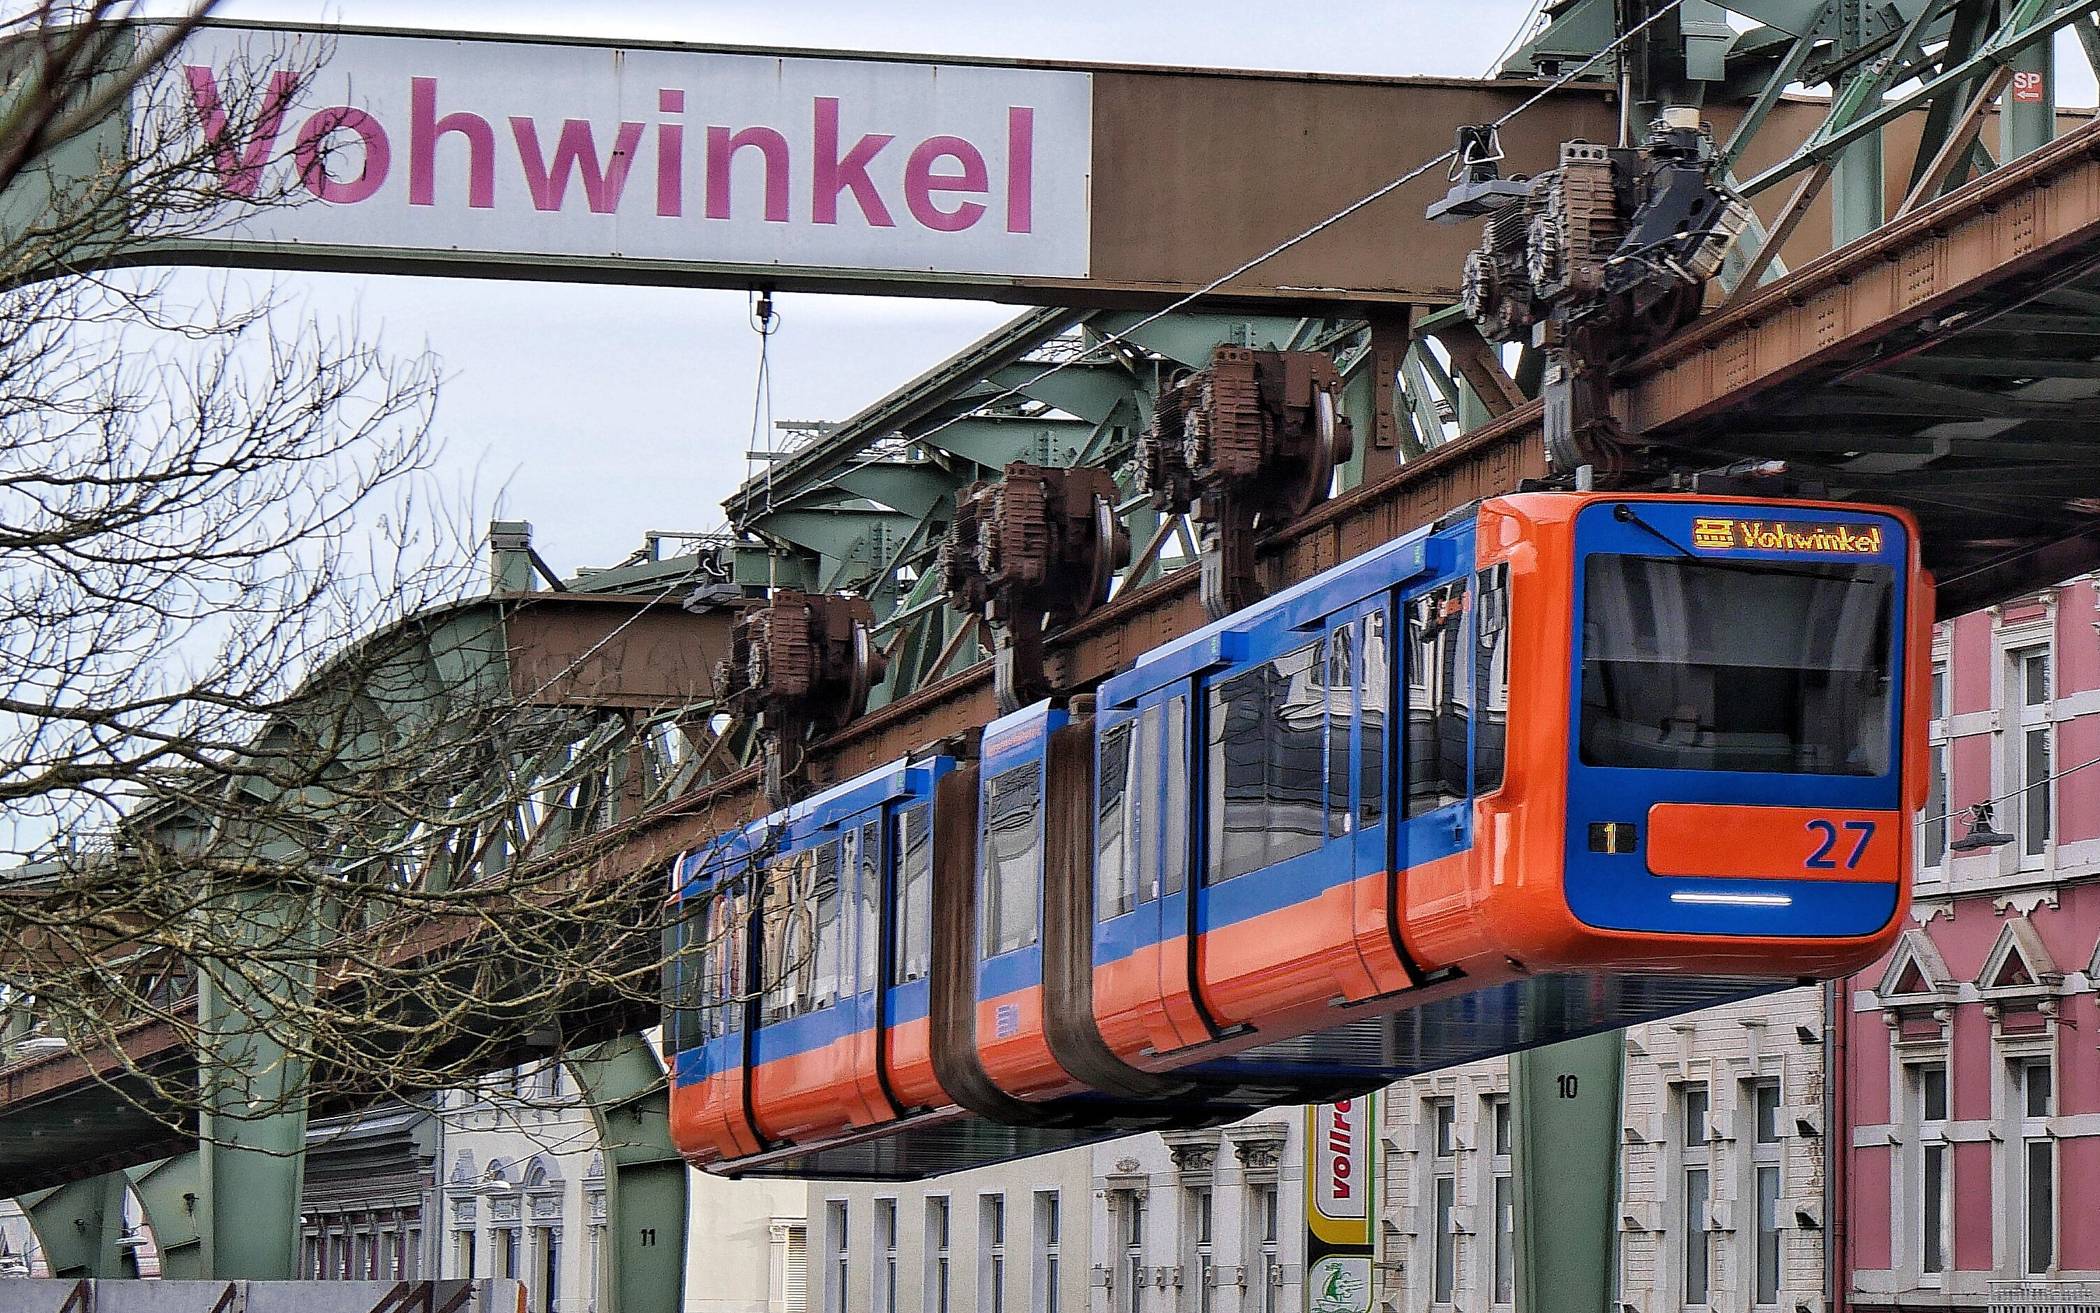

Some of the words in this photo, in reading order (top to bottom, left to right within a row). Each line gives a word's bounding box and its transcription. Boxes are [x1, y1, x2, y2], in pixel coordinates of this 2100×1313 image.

[2014, 72, 2041, 89] SP
[184, 65, 1034, 233] Vohwinkel
[1741, 522, 1882, 552] Vohwinkel
[1604, 823, 1616, 854] 1
[1804, 819, 1876, 869] 27
[1557, 1074, 1578, 1099] 10
[640, 1228, 656, 1247] 11
